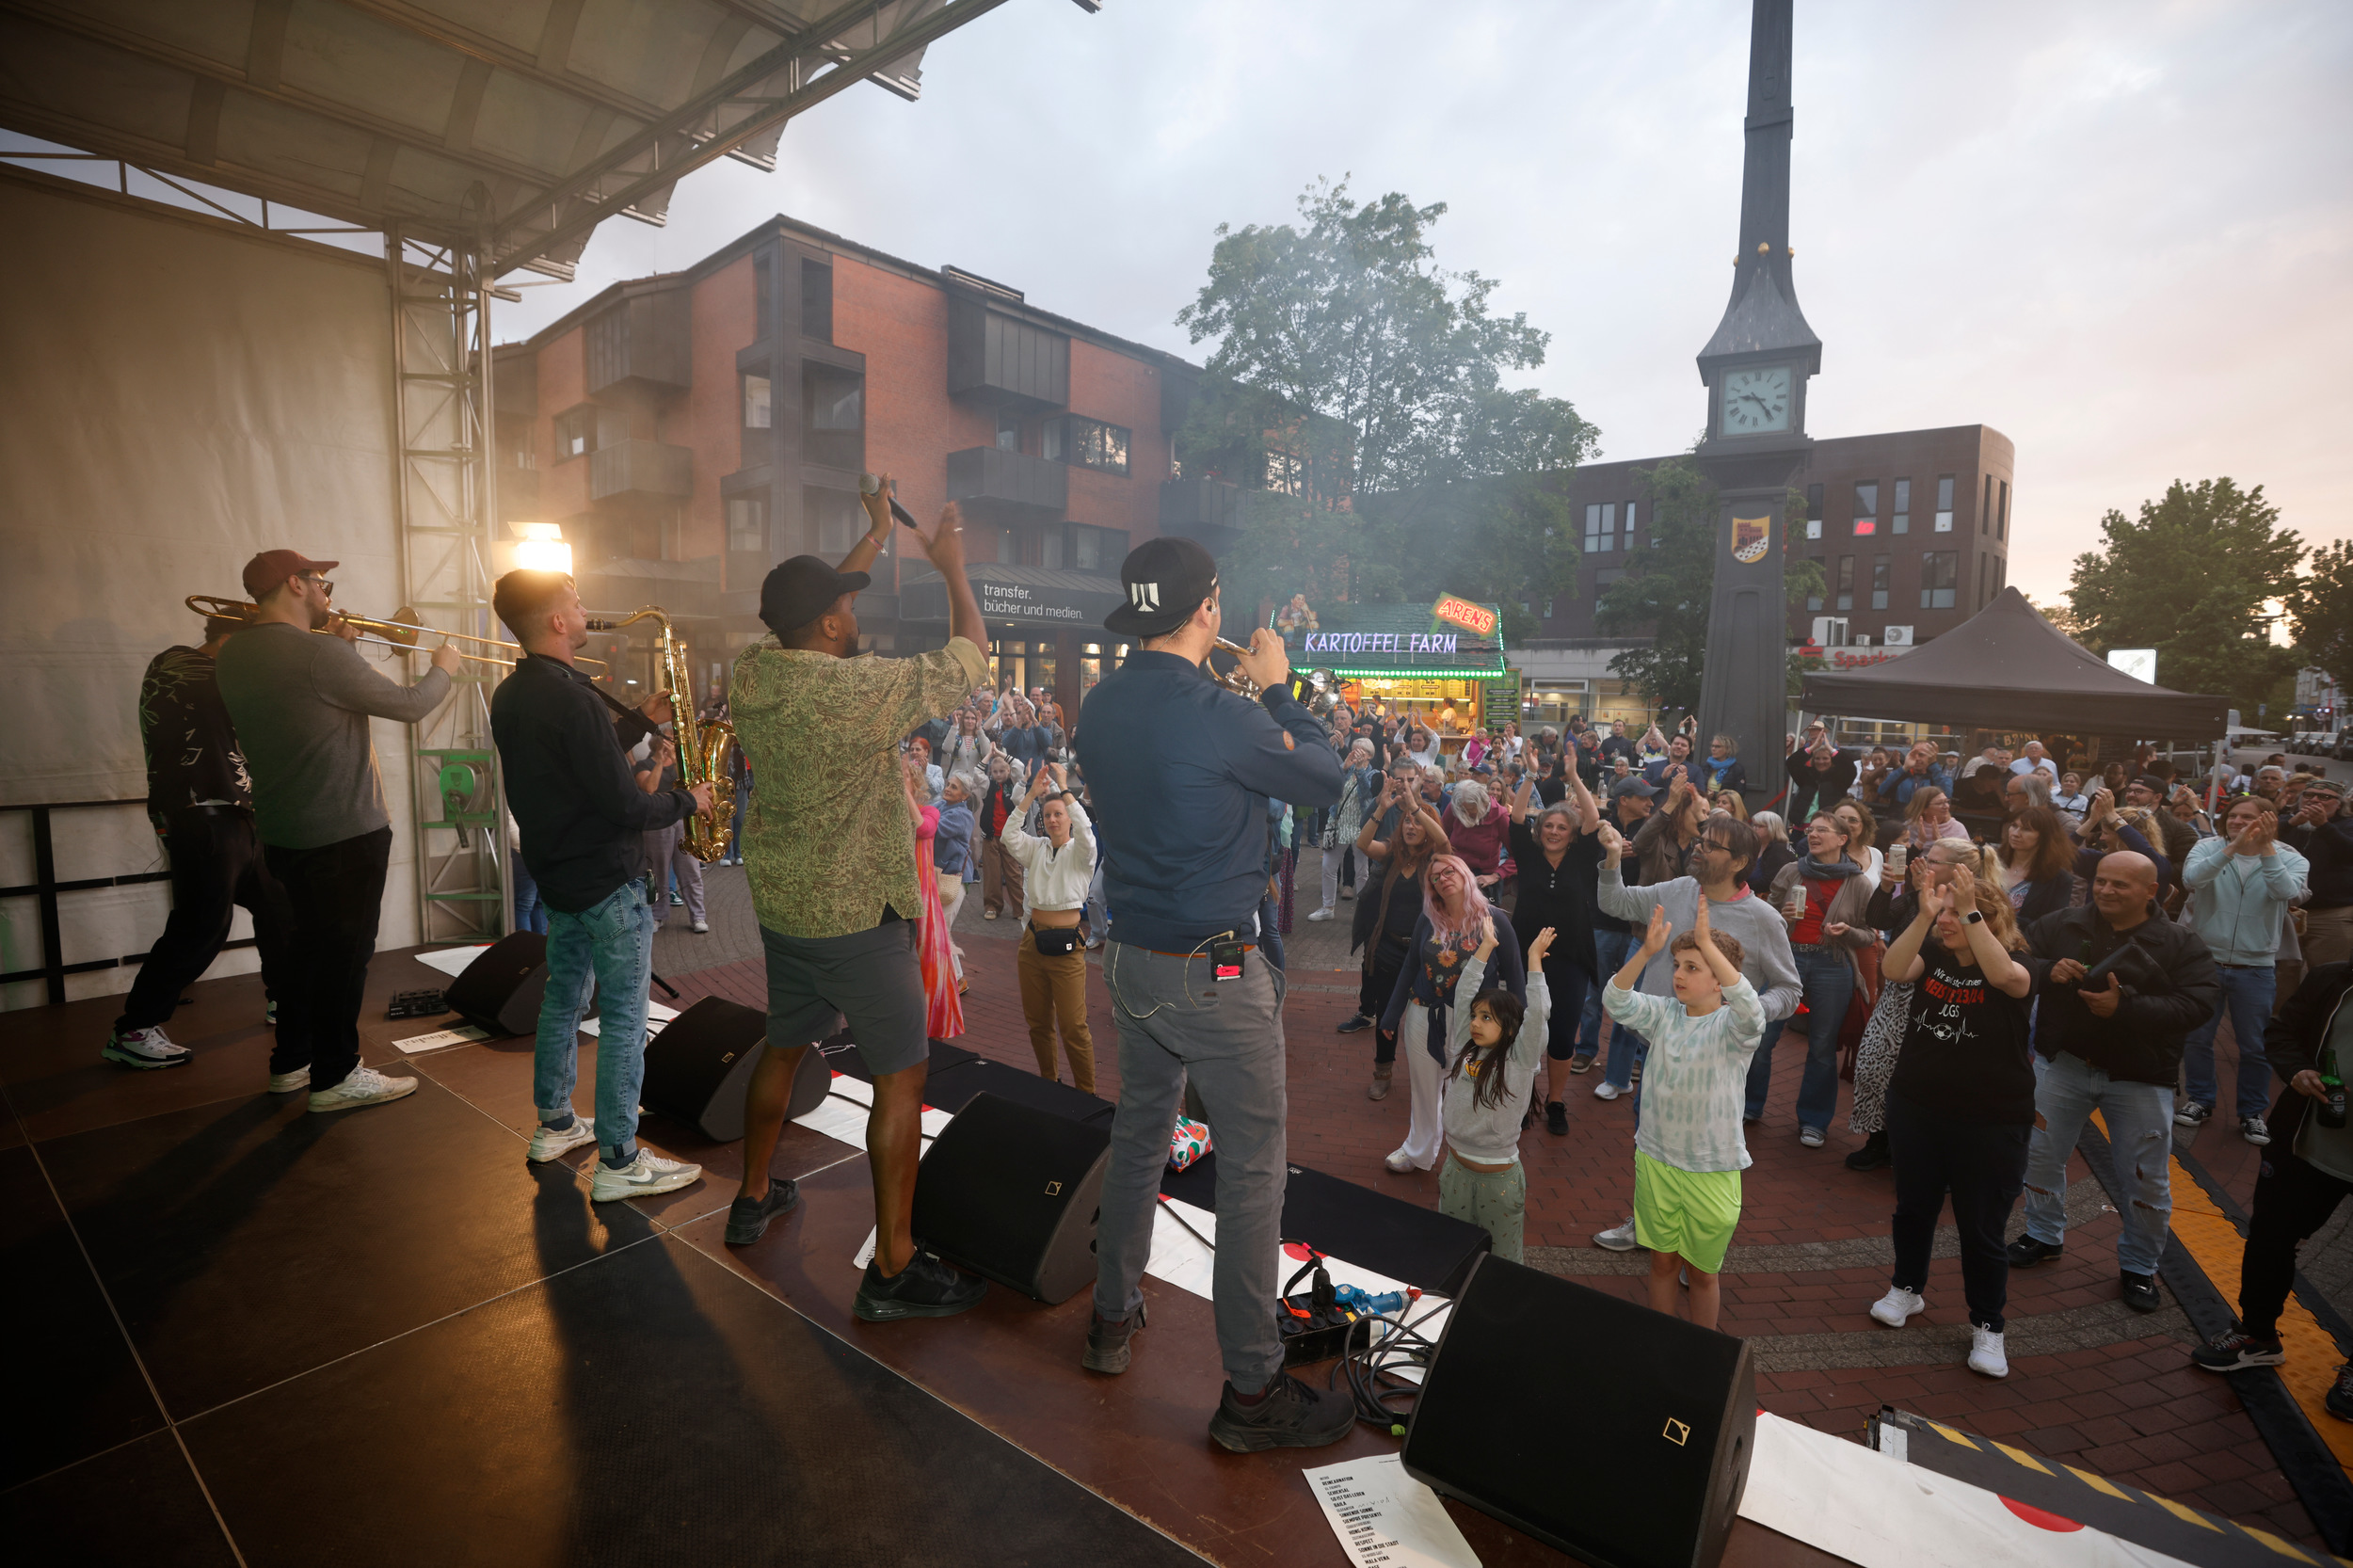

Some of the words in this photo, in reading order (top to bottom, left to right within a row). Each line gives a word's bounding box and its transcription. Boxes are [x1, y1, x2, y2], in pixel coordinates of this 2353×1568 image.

[984, 584, 1032, 600] transfer.
[984, 599, 1020, 614] bücher
[1023, 603, 1043, 616] und
[1046, 607, 1083, 619] medien.
[1437, 600, 1494, 632] ARENS
[1305, 632, 1402, 653] KARTOFFEL
[1410, 632, 1457, 654] FARM
[1833, 650, 1898, 669] Spark
[1385, 1540, 1400, 1548] STADT
